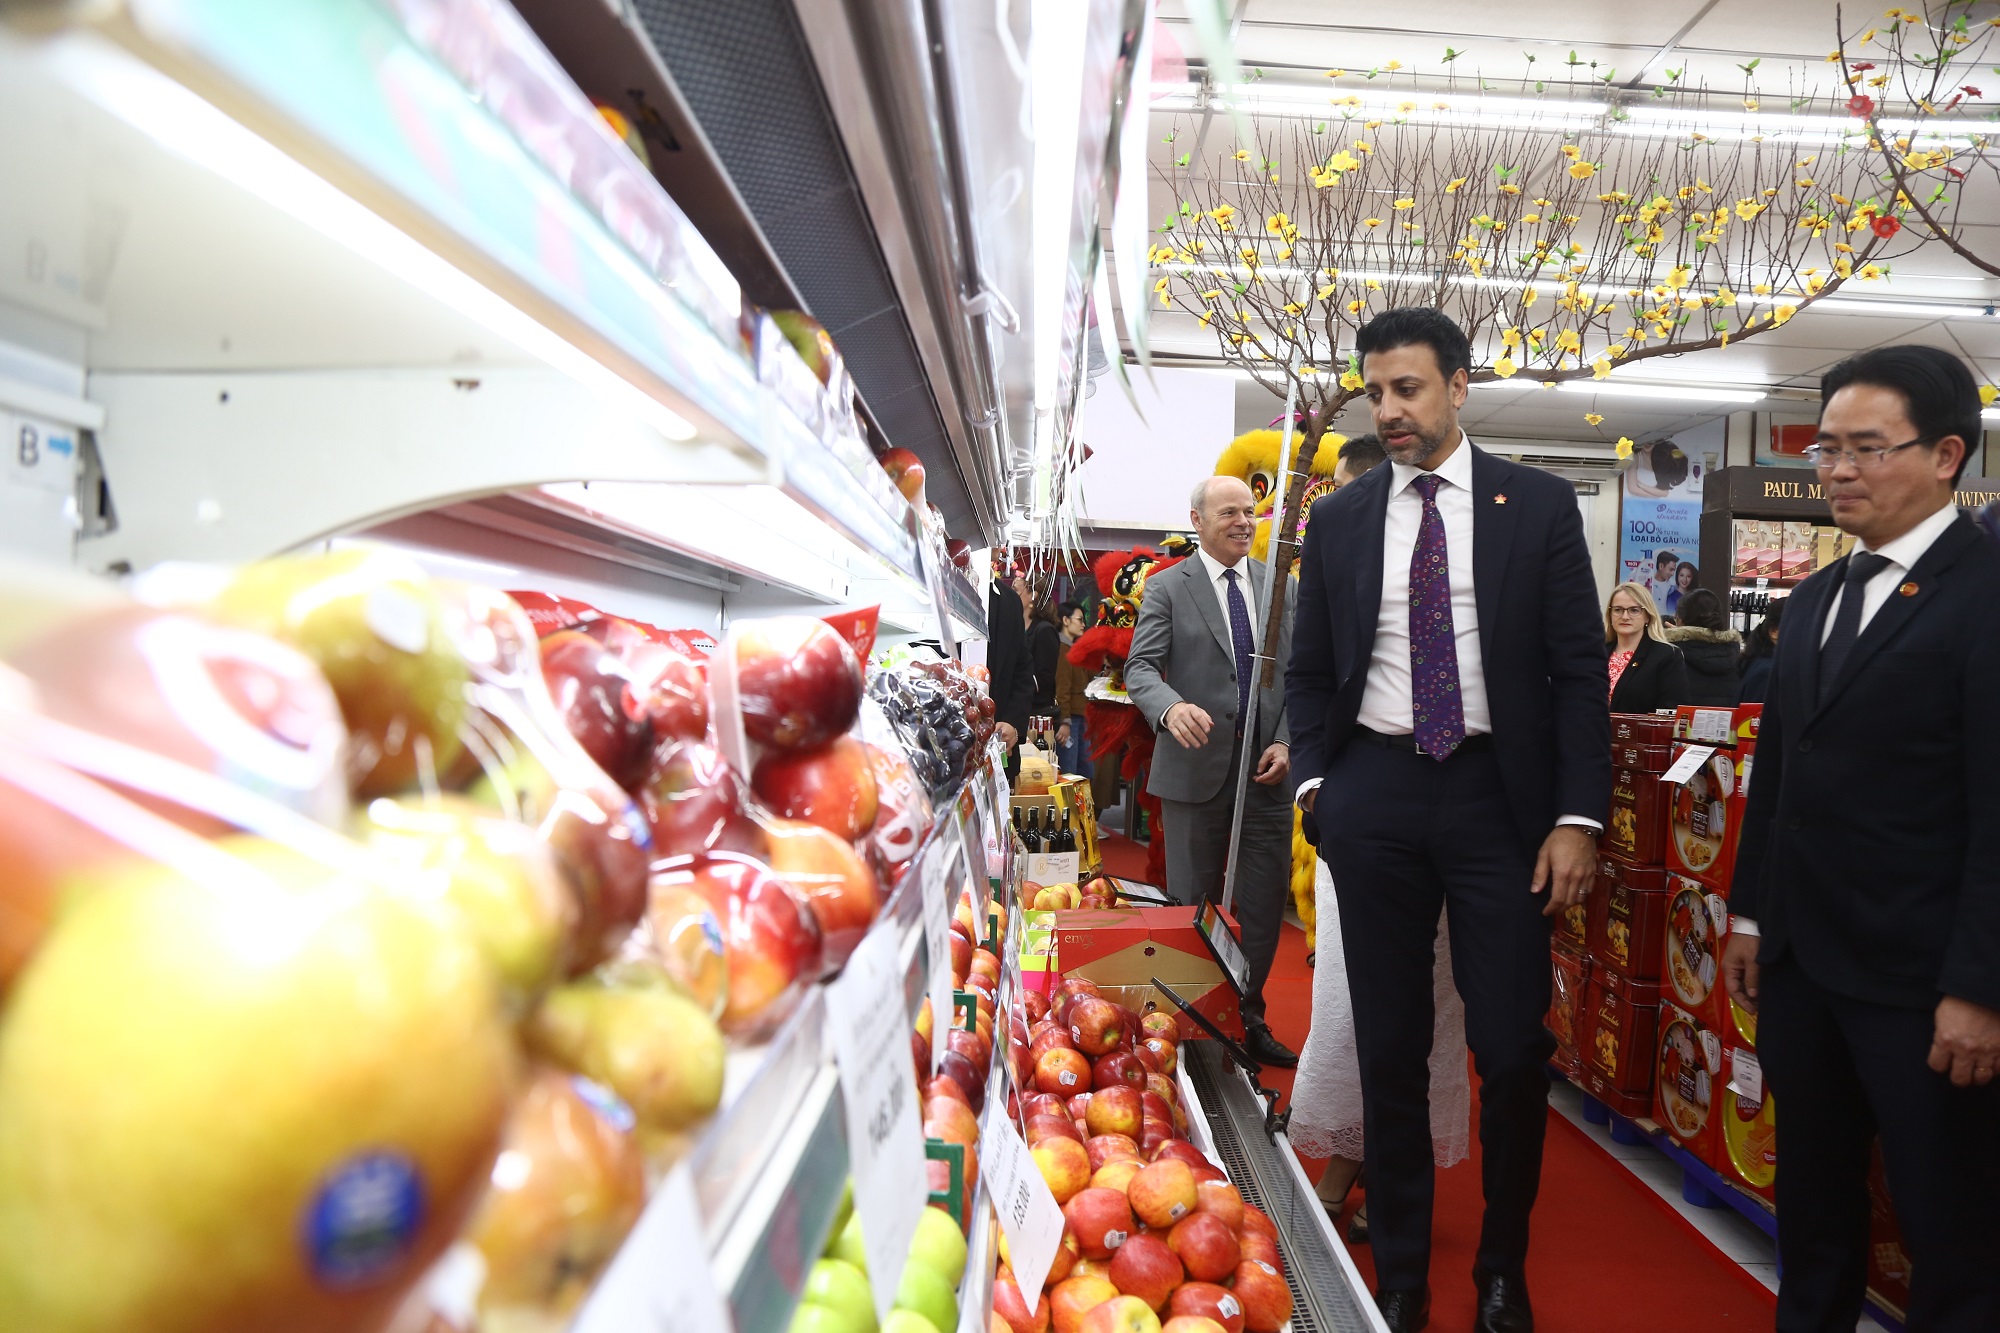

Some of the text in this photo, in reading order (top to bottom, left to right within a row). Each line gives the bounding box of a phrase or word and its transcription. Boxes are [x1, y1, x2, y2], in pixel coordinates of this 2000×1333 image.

[19, 424, 39, 467] B
[1763, 481, 1804, 498] PAUL
[1807, 483, 1827, 499] M
[1630, 520, 1663, 535] 100%
[1631, 535, 1649, 544] LOẠI
[1650, 535, 1661, 543] BỎ
[1613, 785, 1636, 801] Chocolate
[1064, 934, 1095, 950] envy
